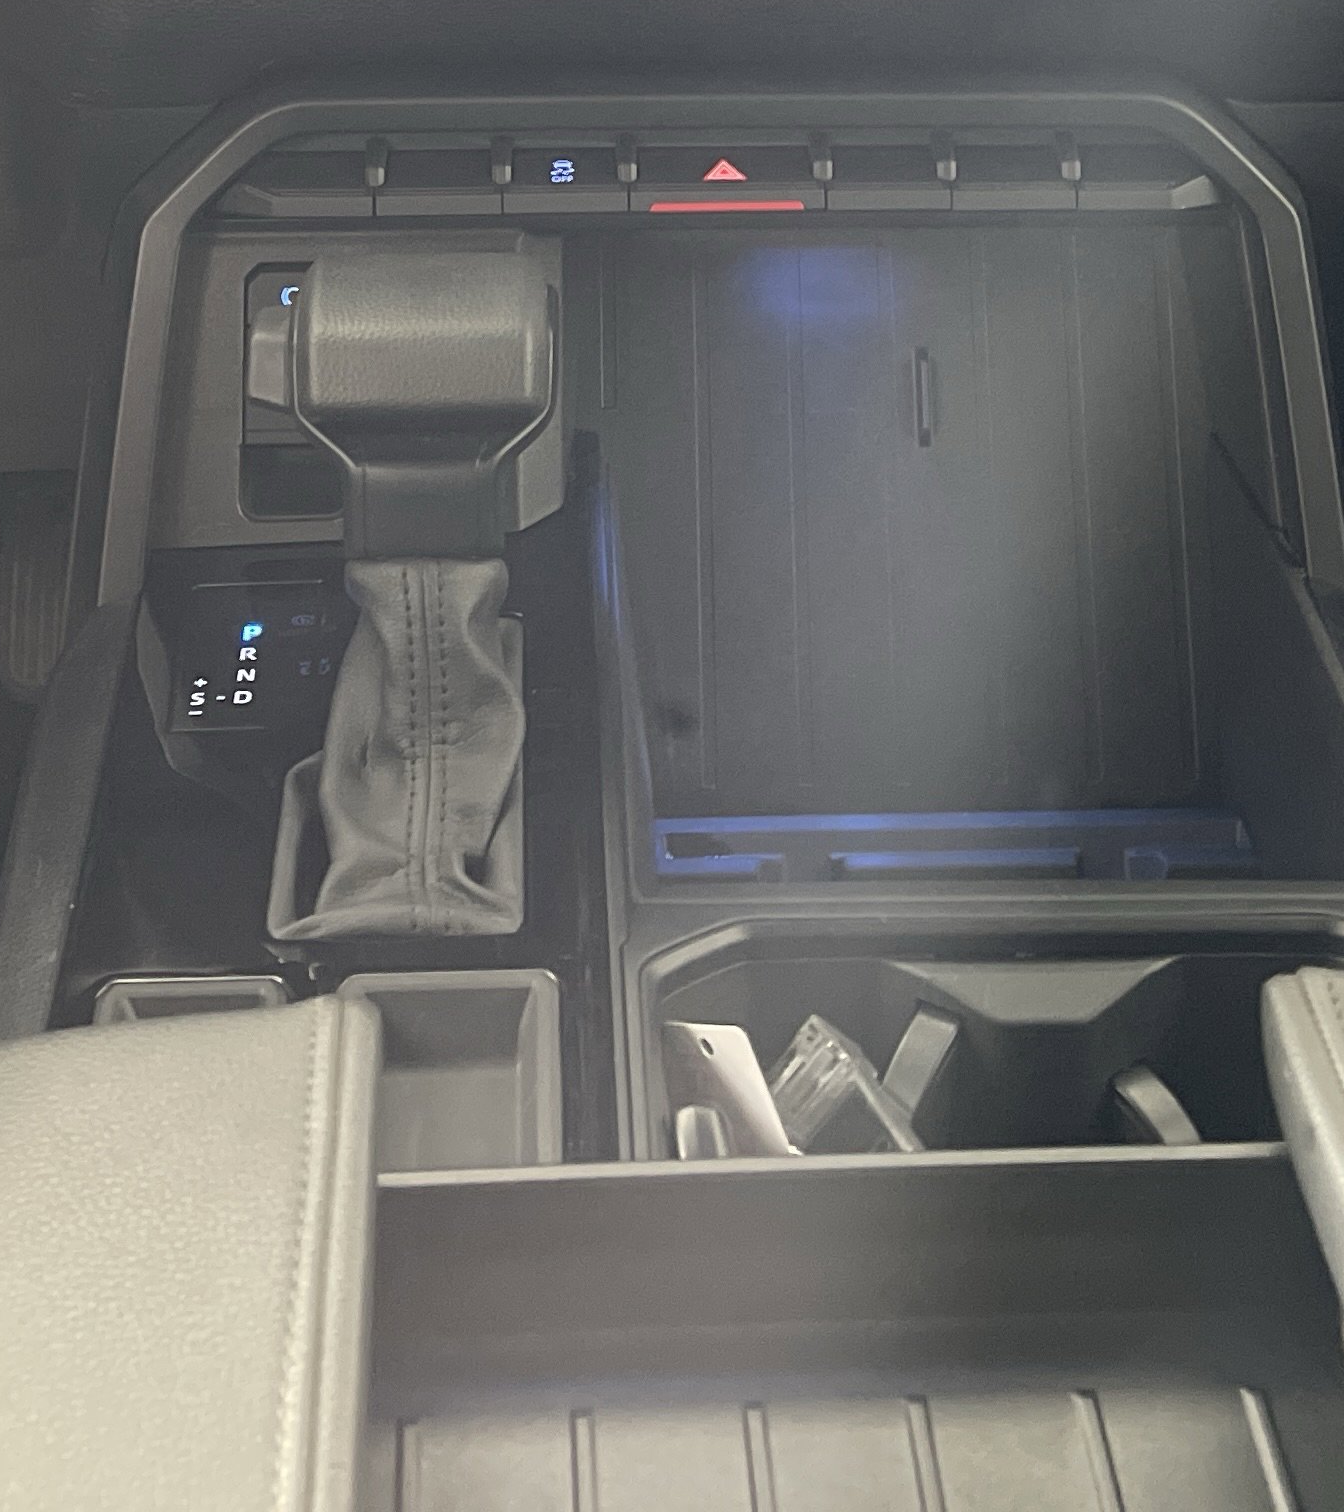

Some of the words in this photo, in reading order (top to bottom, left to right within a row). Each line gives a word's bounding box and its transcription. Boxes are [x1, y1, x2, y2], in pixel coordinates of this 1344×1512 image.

[242, 624, 264, 642] P
[239, 646, 257, 662] R
[236, 668, 256, 683] N
[189, 691, 206, 706] S
[232, 689, 253, 705] D
